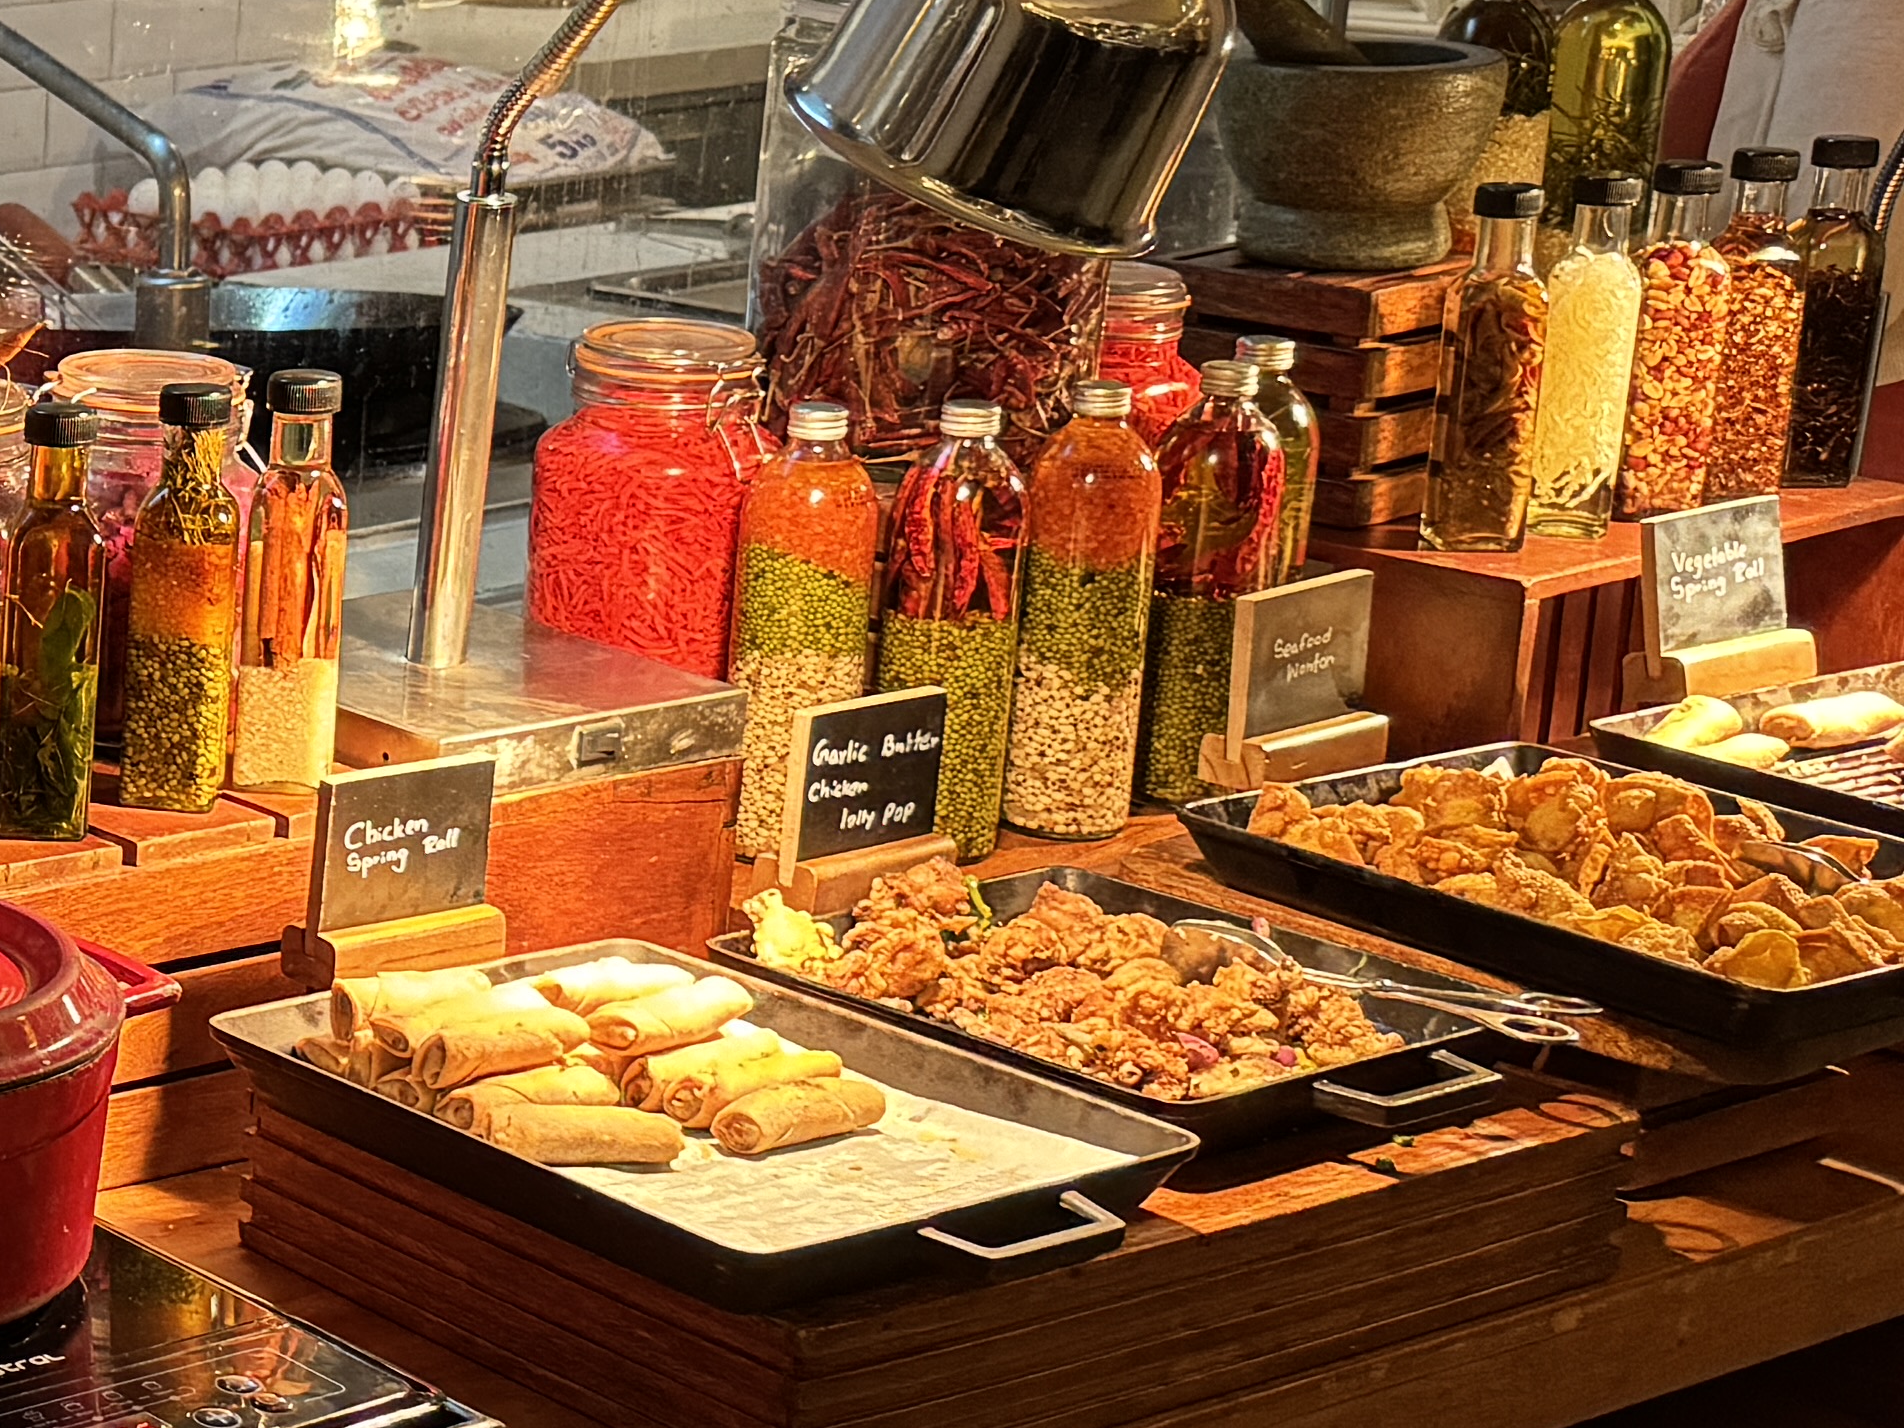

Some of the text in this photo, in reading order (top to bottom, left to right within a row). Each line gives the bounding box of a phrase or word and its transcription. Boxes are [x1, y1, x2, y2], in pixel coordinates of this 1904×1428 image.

[1671, 540, 1747, 580] Vegetable
[1670, 556, 1765, 604] Spring Roll
[1274, 626, 1333, 659] Seafood
[812, 729, 940, 767] Garlic Butter
[344, 817, 430, 850] Chicken
[346, 827, 461, 879] Spring Roll
